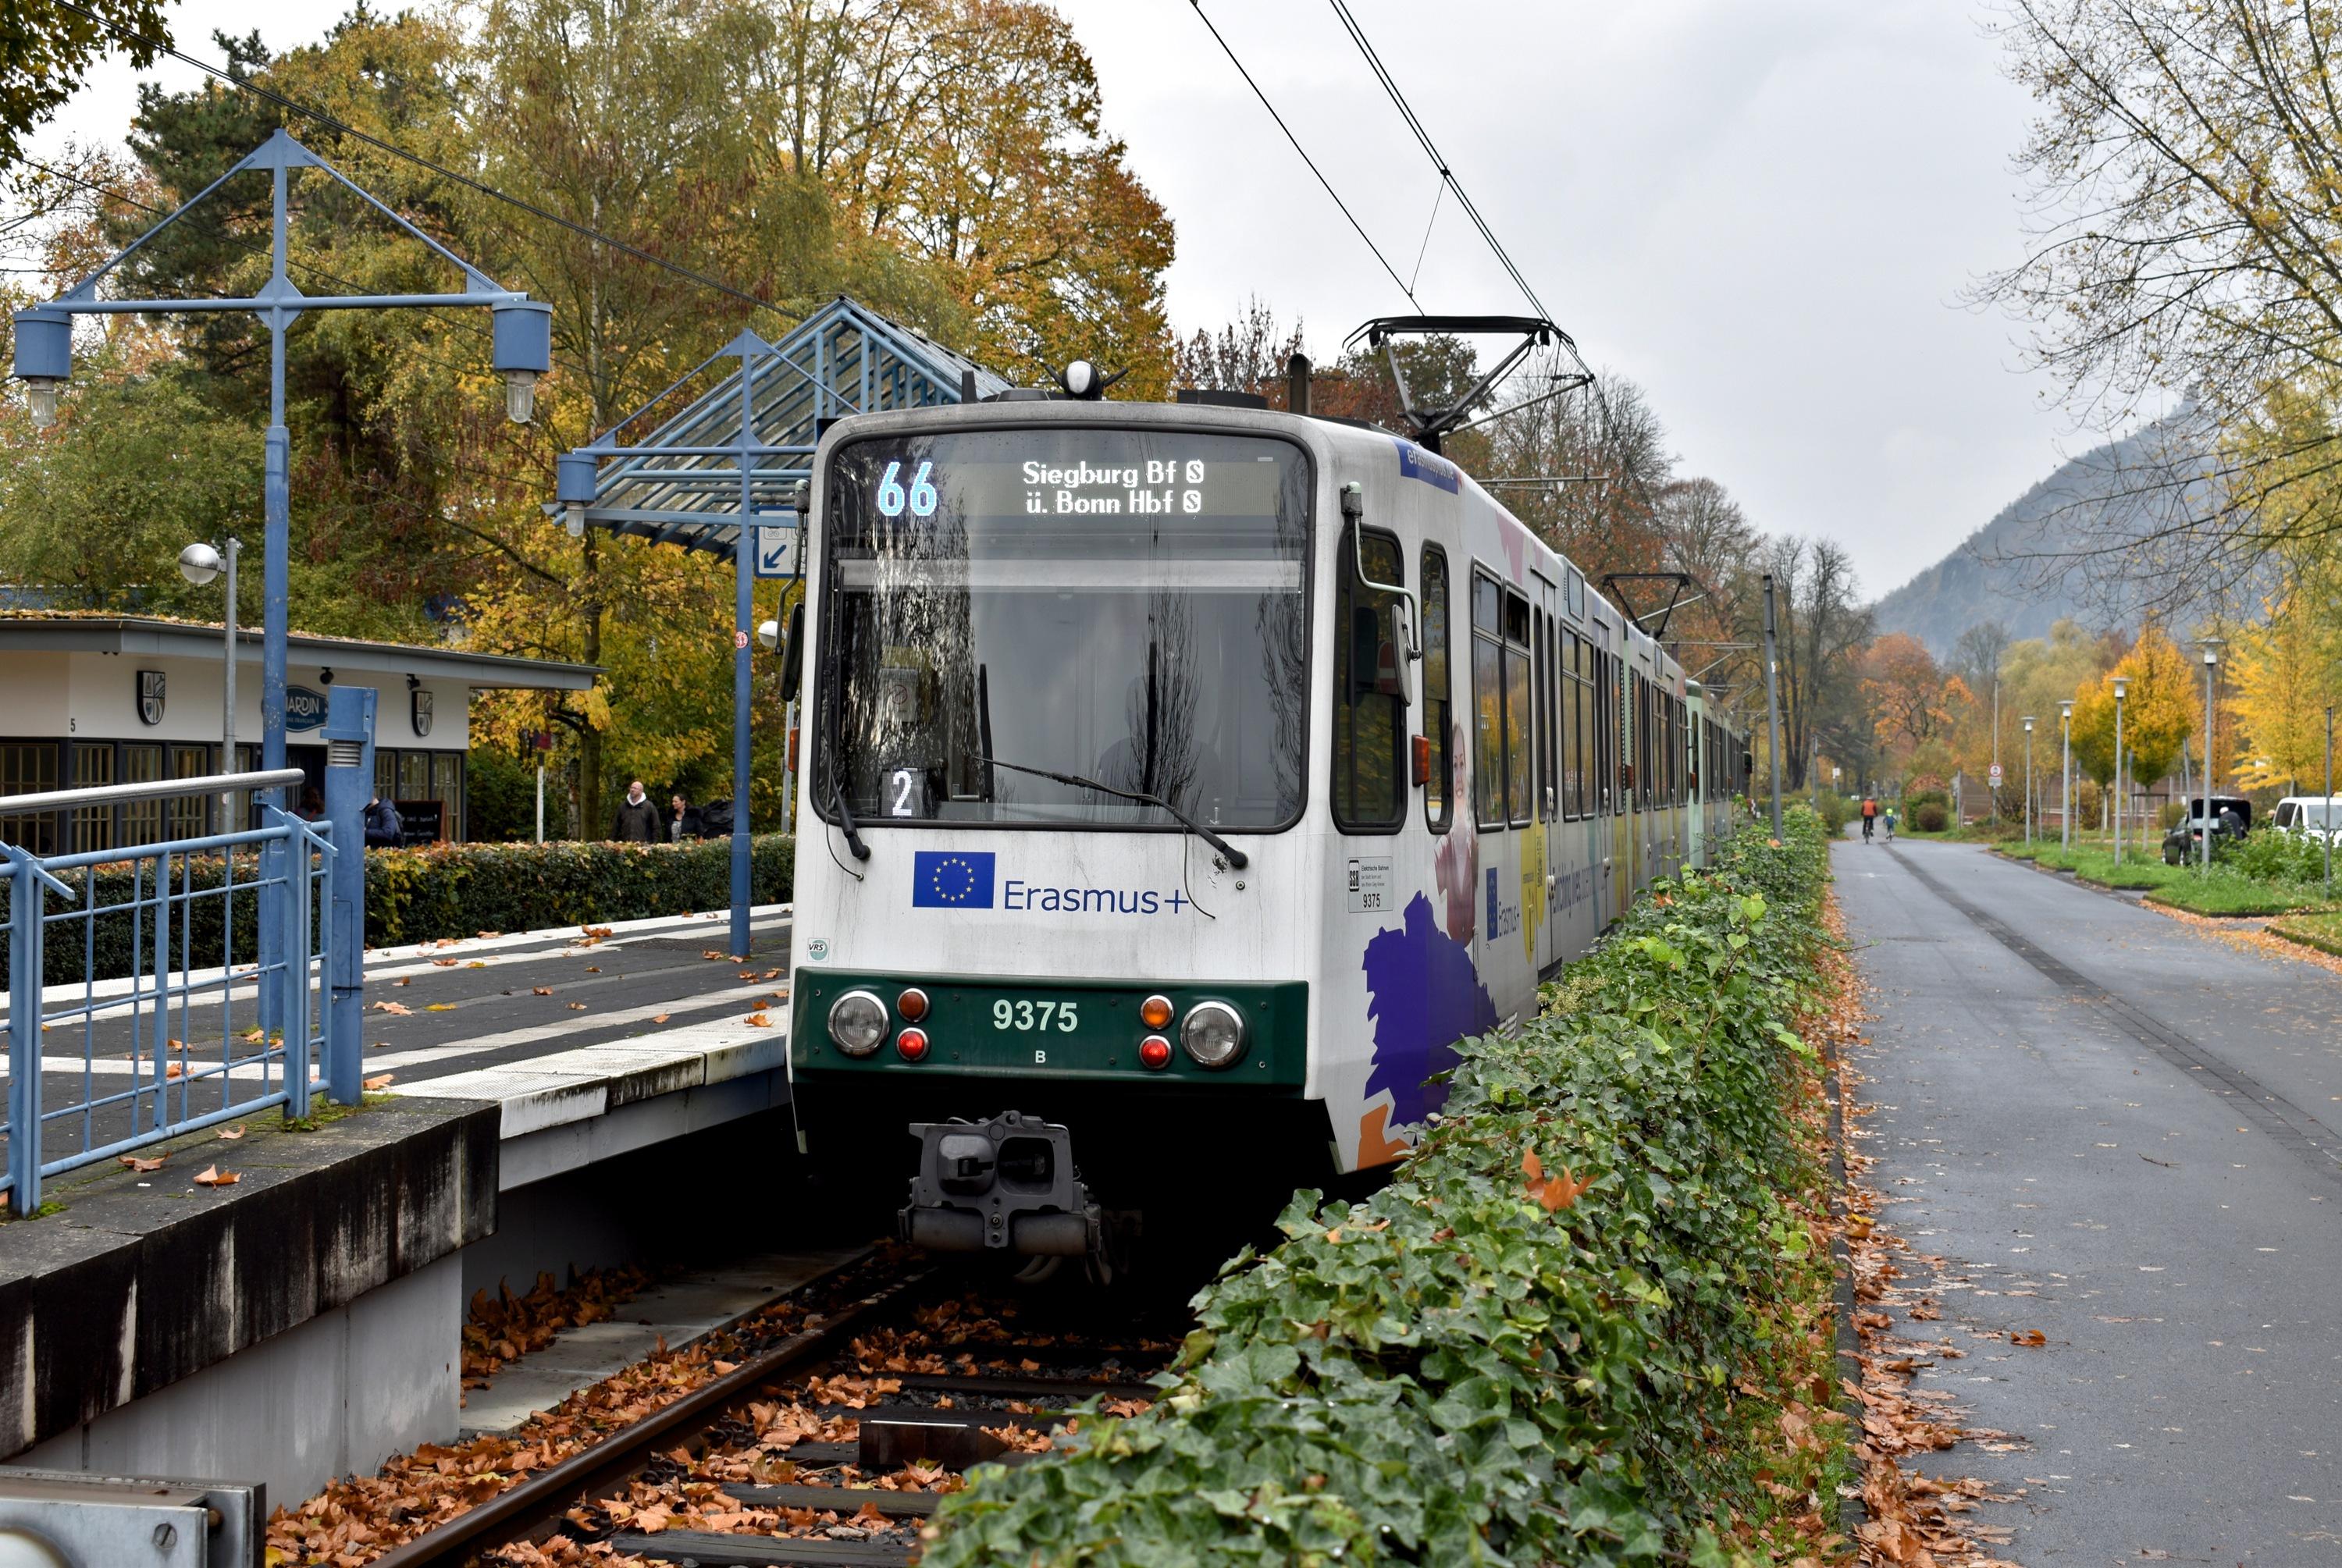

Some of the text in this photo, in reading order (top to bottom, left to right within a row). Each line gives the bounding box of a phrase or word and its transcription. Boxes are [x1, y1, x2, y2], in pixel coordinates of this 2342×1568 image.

[1023, 460, 1138, 488] Siegburg
[1146, 460, 1176, 485] Bf
[877, 461, 937, 517] 66
[1027, 491, 1047, 514] ü.
[1057, 490, 1120, 514] Bonn
[1129, 490, 1174, 514] Hbf
[70, 717, 76, 733] 5
[892, 770, 913, 816] 2
[1004, 880, 1189, 915] Erasmus+
[1363, 893, 1381, 908] 9375
[993, 999, 1078, 1033] 9375
[1035, 1050, 1047, 1064] B
